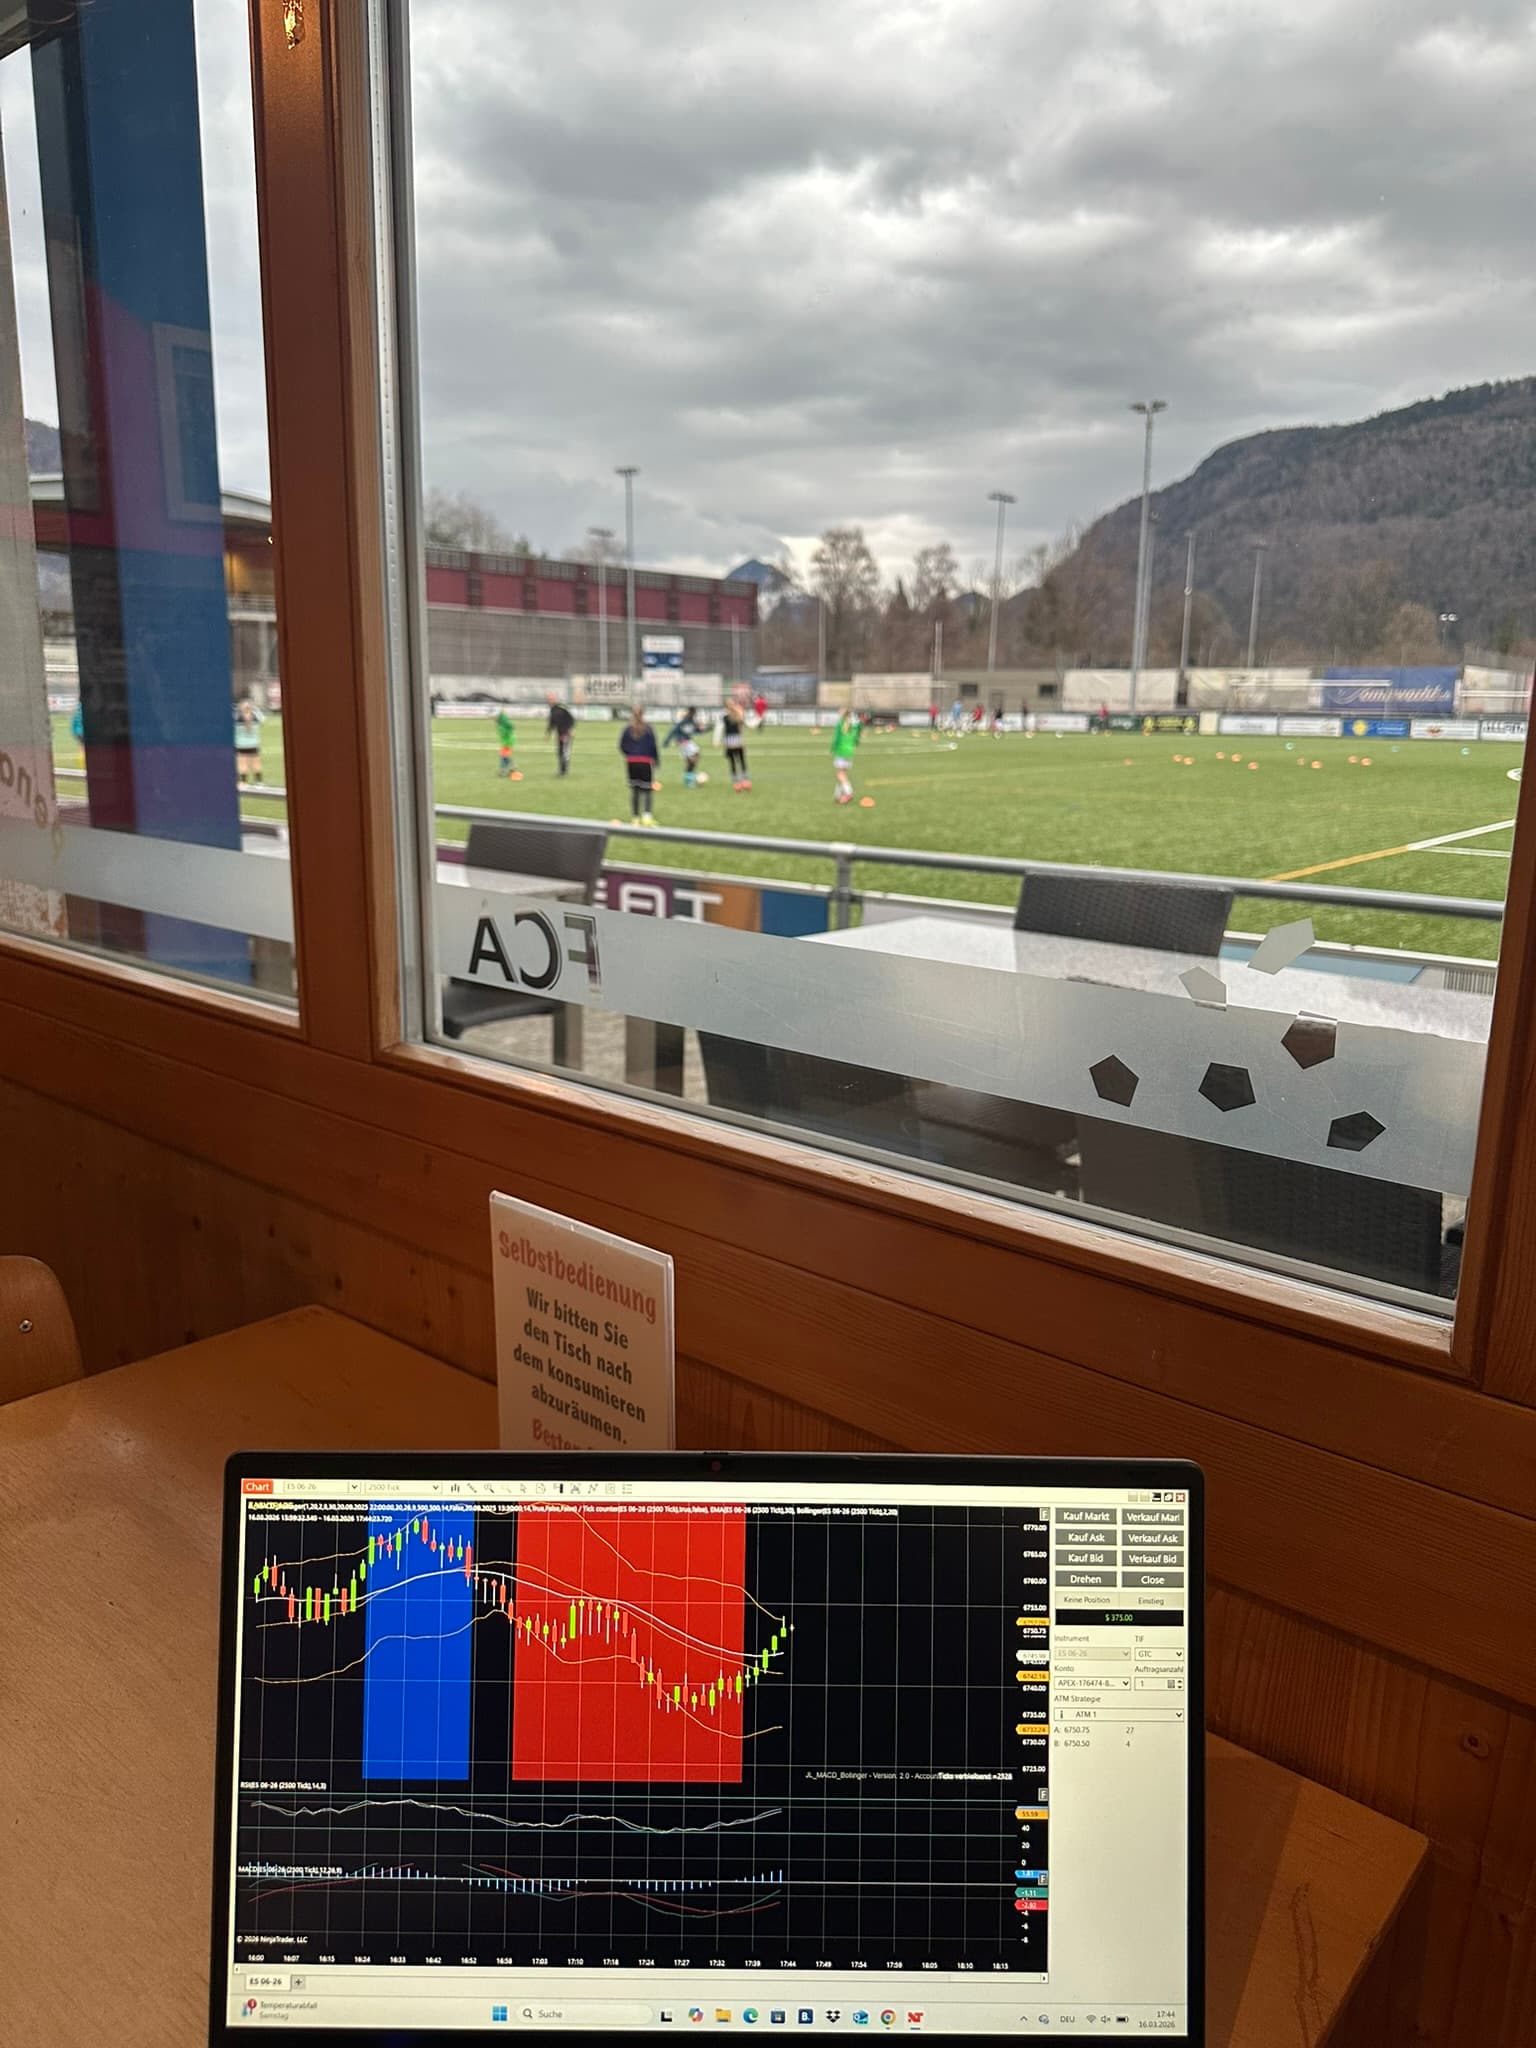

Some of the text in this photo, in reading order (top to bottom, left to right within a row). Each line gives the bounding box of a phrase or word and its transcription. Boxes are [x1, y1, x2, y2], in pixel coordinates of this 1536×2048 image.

[499, 1231, 656, 1324] Selbstbedienung
[526, 1287, 629, 1349] Wir bitten Sie
[524, 1318, 632, 1384] den Tisch nach
[513, 1344, 645, 1422] dem konsumieren
[532, 1384, 627, 1444] abzuräumen.
[245, 1482, 270, 1492] Chart
[369, 1484, 385, 1492] 2500
[1063, 1511, 1110, 1521] Kauf Markt
[1126, 1512, 1159, 1522] Verkauf
[1068, 1532, 1105, 1542] Kauf Ask
[1128, 1533, 1179, 1543] Verkauf Ask
[1068, 1553, 1104, 1563] Kauf Bid
[1128, 1553, 1177, 1564] Verkauf Bid
[1070, 1574, 1102, 1584] Drehen
[1141, 1575, 1165, 1585] Close
[1111, 1613, 1134, 1622] 375.00
[1138, 1650, 1153, 1659] GTC
[1054, 1664, 1075, 1673] Konto
[1134, 1665, 1184, 1675] Auftragsanzahl
[1054, 1694, 1070, 1703] ATM
[1075, 1710, 1090, 1719] ATM
[1064, 1726, 1090, 1735] 6750.75
[1126, 1726, 1135, 1735] 27
[538, 2009, 562, 2018] Suche
[1060, 2014, 1075, 2023] DEU
[1157, 2010, 1175, 2019] 17:44
